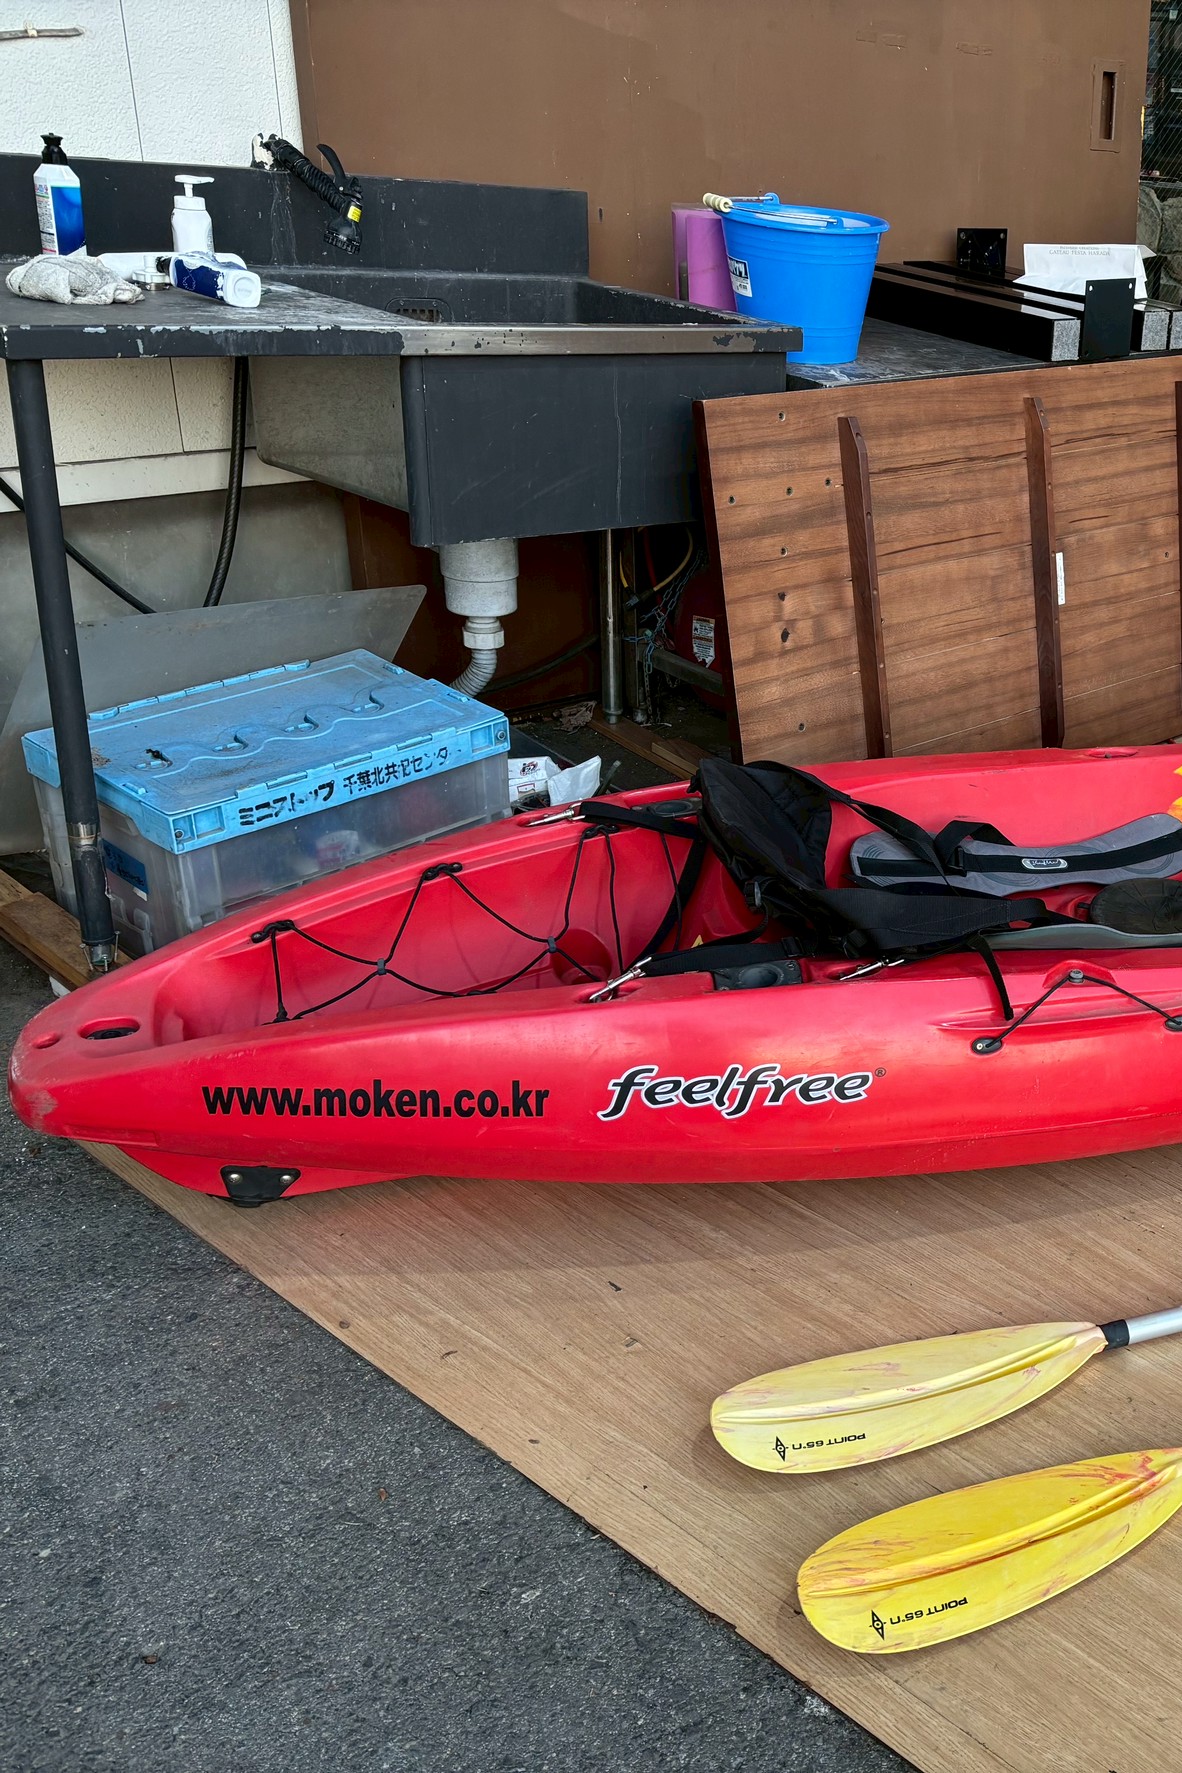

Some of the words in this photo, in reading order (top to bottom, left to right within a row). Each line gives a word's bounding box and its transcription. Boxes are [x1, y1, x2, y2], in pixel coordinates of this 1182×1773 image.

[238, 779, 335, 827] ミニストップ
[201, 1079, 549, 1118] www.moken.co.kr
[597, 1063, 873, 1121] feelfree
[825, 1433, 867, 1446] POINT
[926, 1597, 969, 1616] POINT
